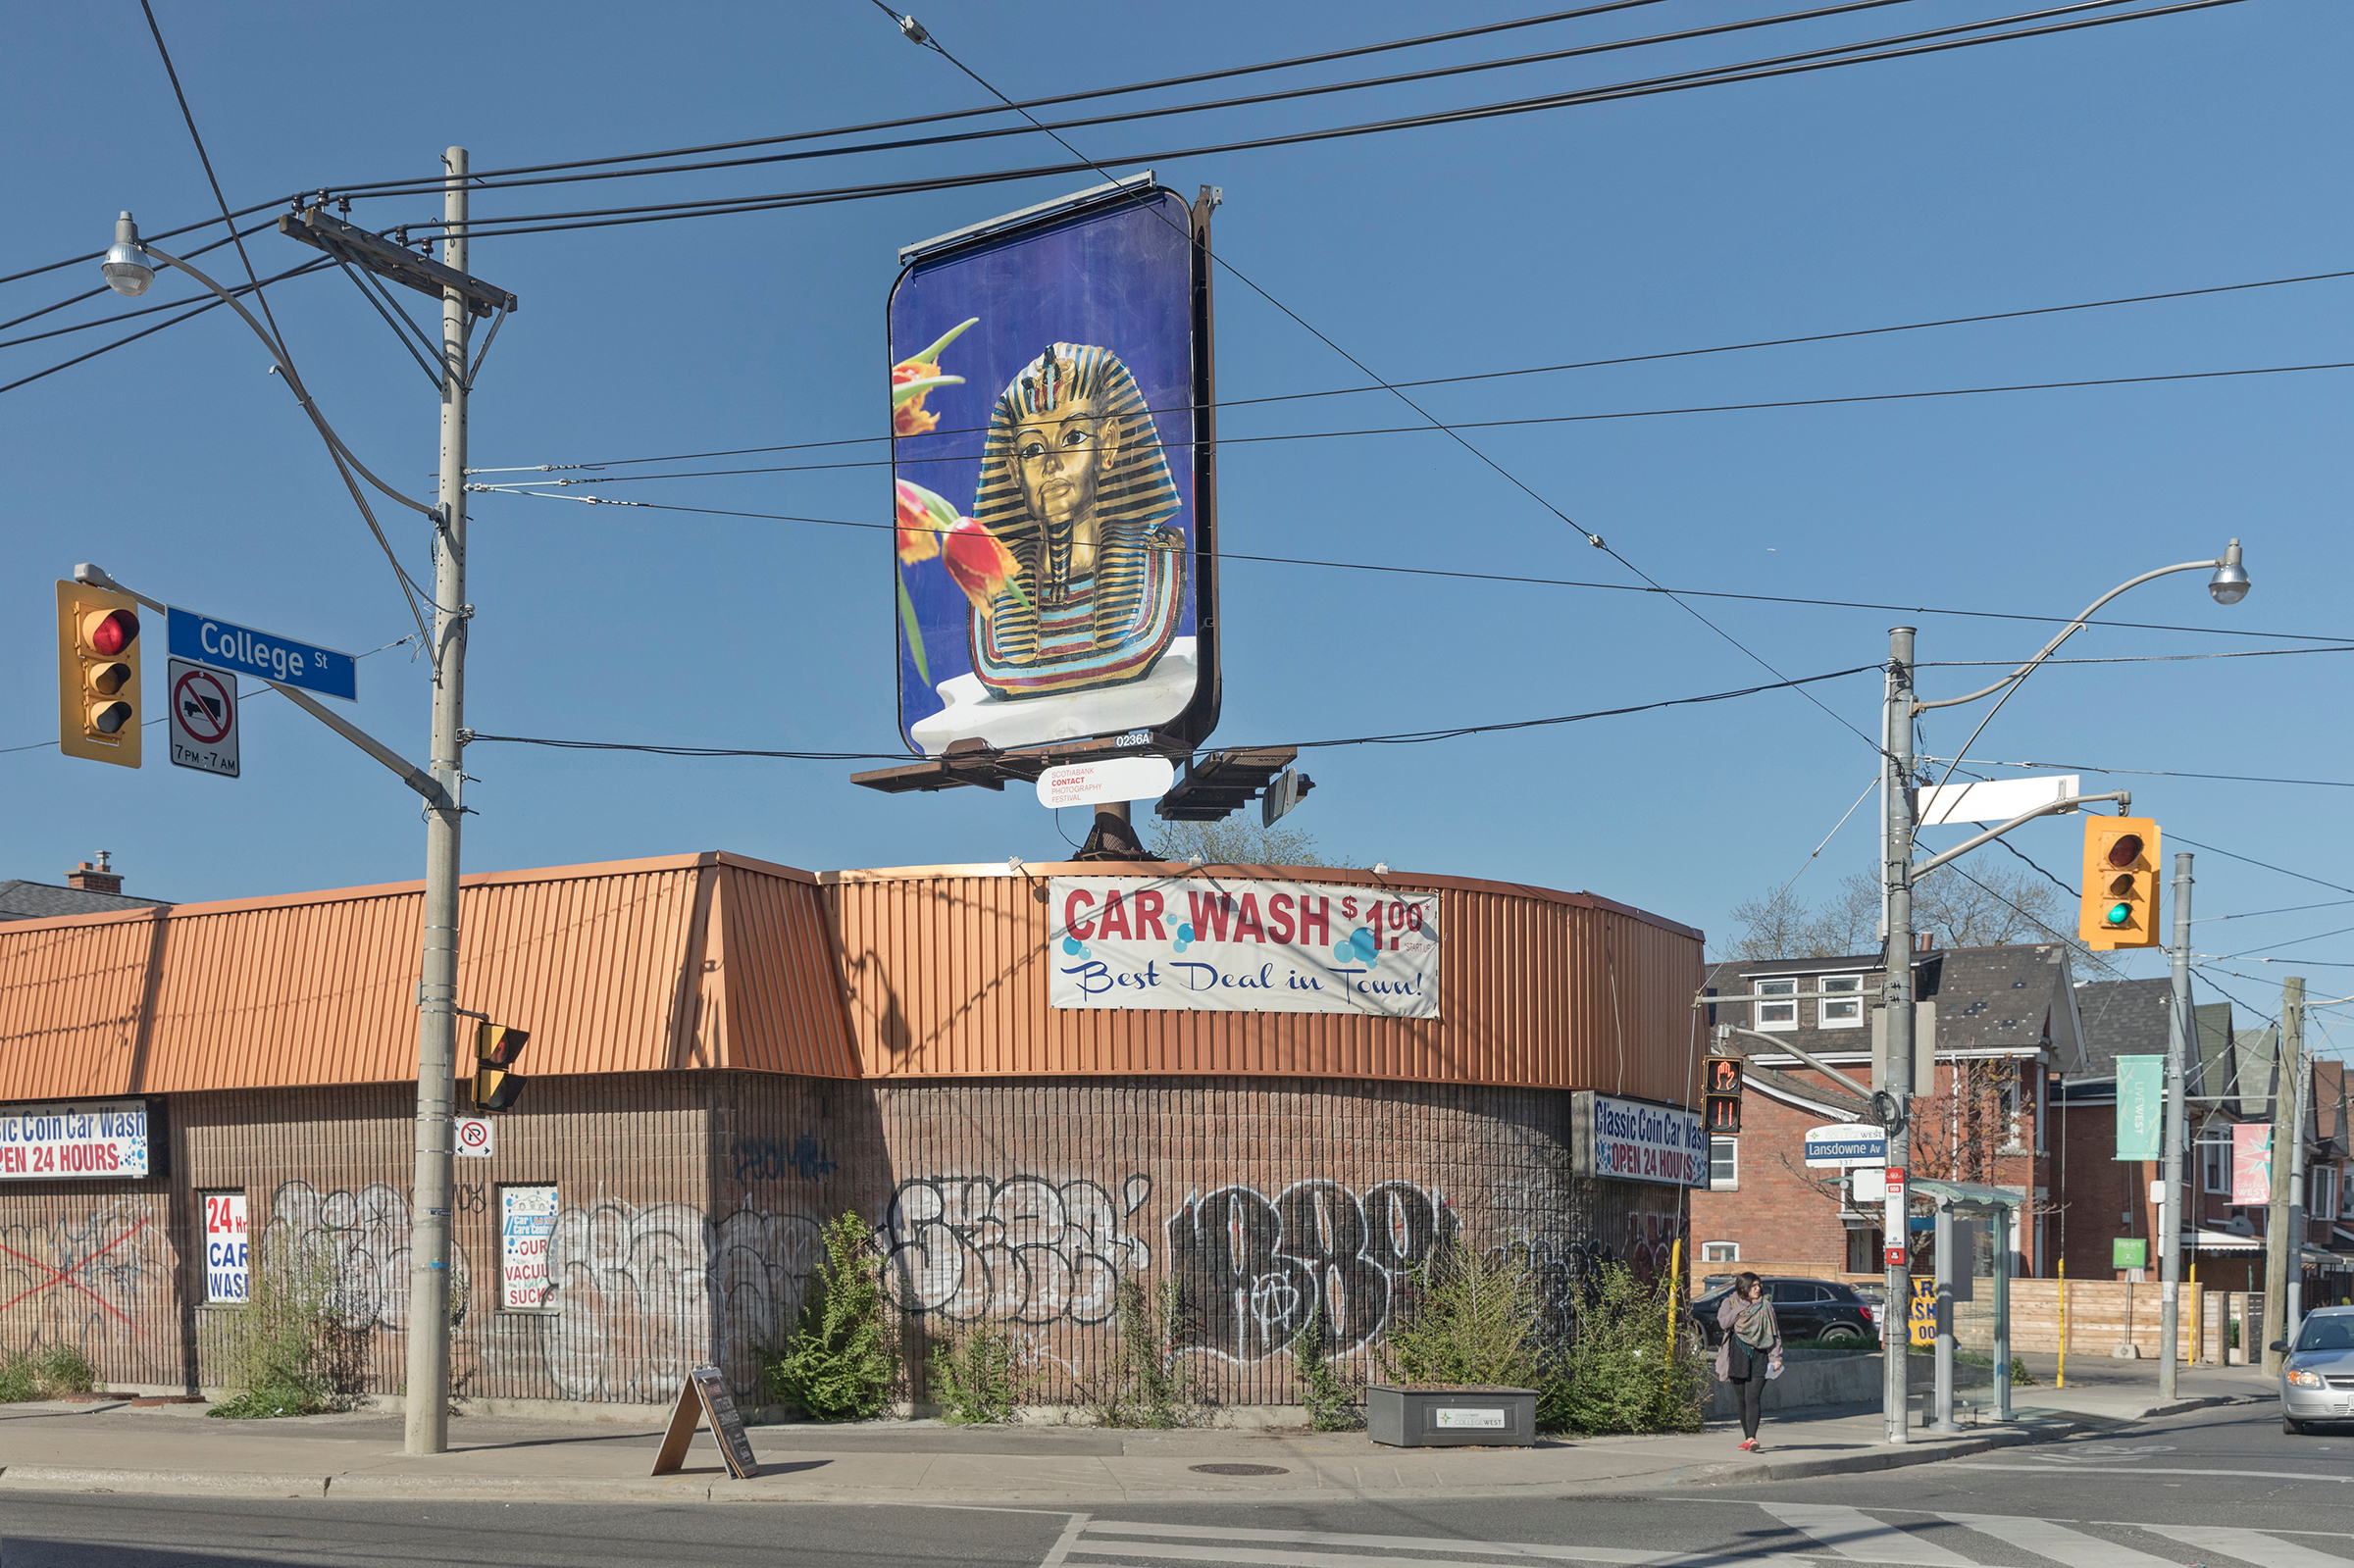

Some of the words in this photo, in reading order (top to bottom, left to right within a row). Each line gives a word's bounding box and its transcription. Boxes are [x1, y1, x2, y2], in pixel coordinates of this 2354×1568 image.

[200, 622, 304, 681] College
[314, 651, 329, 670] St
[1116, 733, 1151, 747] 0236A
[1051, 767, 1095, 779] SCOTIABANK
[1051, 777, 1085, 787] CONTACT
[1051, 784, 1102, 795] PHOTOGRAPHY
[1051, 794, 1081, 803] FESTIVAL
[1064, 888, 1168, 941] CAR
[1187, 890, 1330, 946] WASH
[1060, 960, 1162, 1002] Best
[1169, 961, 1275, 991] Deal
[1285, 969, 1325, 990] in
[1326, 967, 1422, 1005] Town!
[0, 1112, 18, 1142] ic
[22, 1110, 62, 1141] Coin
[66, 1107, 94, 1139] Car
[99, 1105, 146, 1138] Wash
[1595, 1099, 1636, 1141] Classic
[1638, 1108, 1663, 1144] Coin
[1663, 1113, 1681, 1147] Car
[32, 1145, 55, 1172] 24
[59, 1142, 120, 1172] HOURS
[1612, 1142, 1641, 1175] OPEN
[1644, 1147, 1658, 1176] 24
[1809, 1142, 1867, 1156] Lansdowne
[1869, 1145, 1881, 1154] Av
[208, 1196, 232, 1234] 24
[514, 1216, 529, 1225] Car
[513, 1225, 530, 1235] Care
[209, 1242, 249, 1267] CAR
[520, 1239, 548, 1256] OUR
